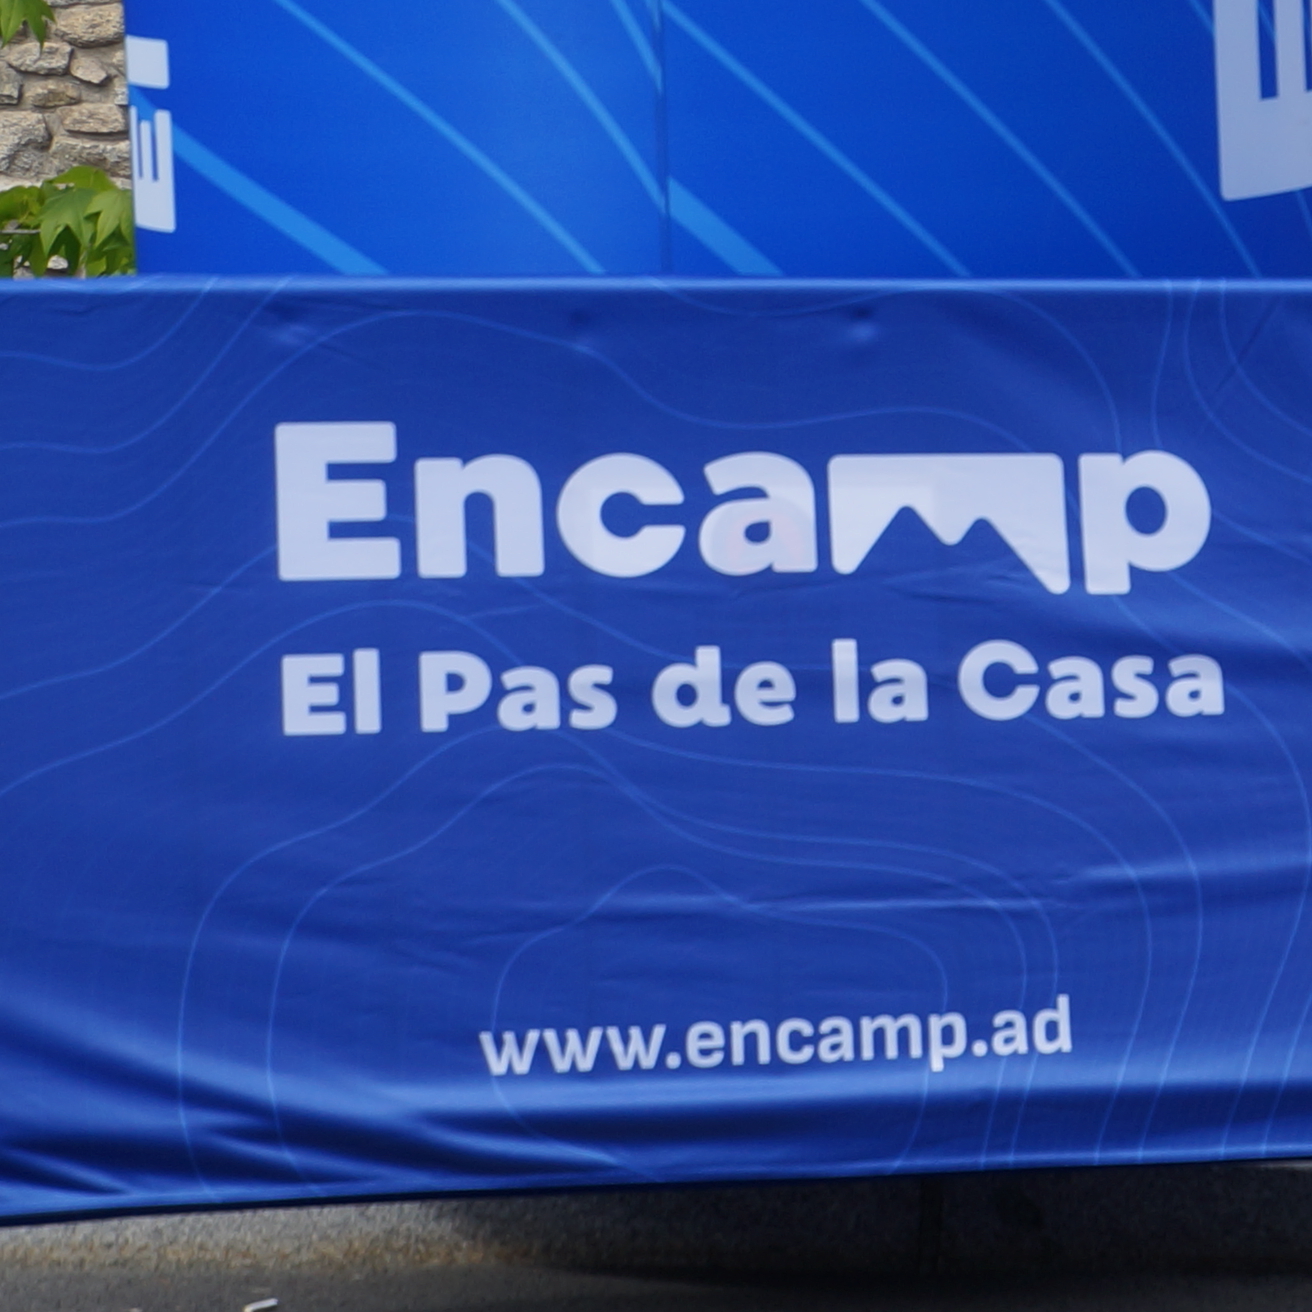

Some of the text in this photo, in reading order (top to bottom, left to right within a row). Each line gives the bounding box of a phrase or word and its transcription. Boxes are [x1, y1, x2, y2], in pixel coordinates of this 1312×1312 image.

[126, 36, 176, 233] El
[274, 421, 1212, 595] Encamp
[281, 638, 1225, 736] El Pas de la Casa
[479, 994, 1073, 1076] www.encamp.ad
